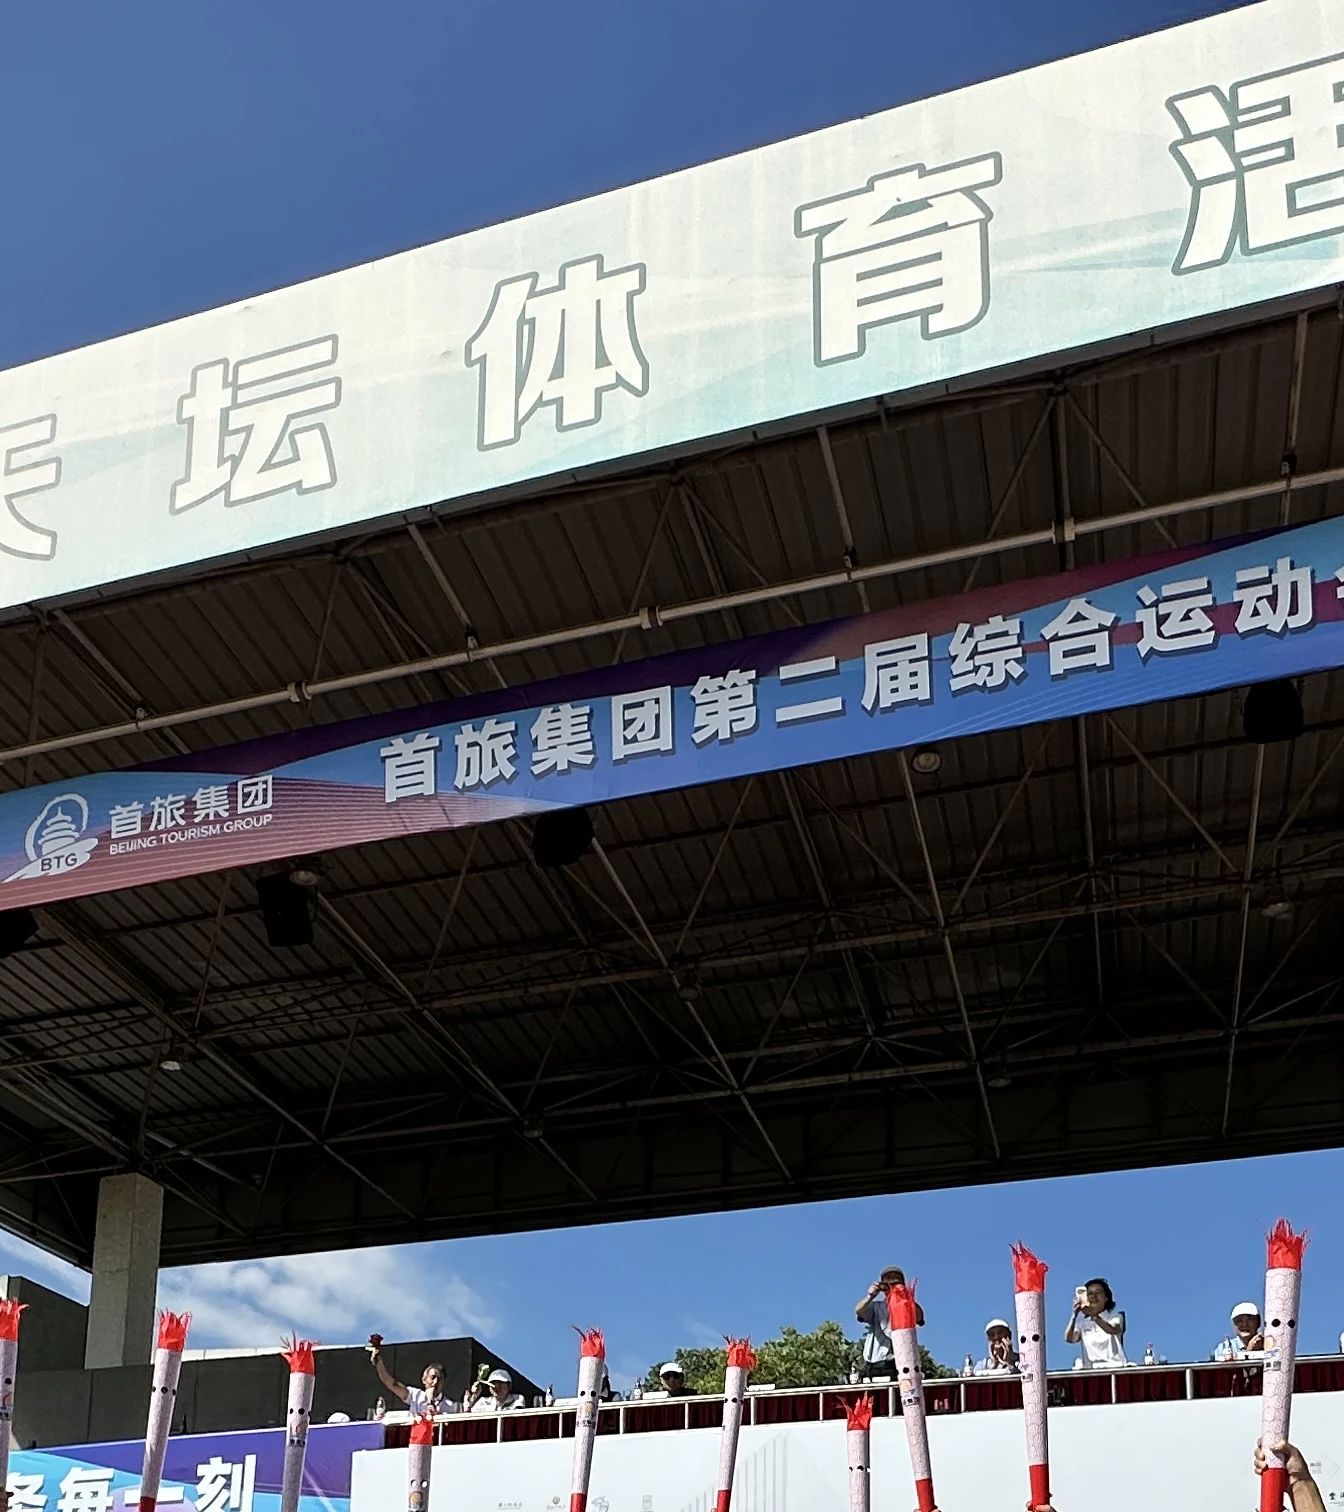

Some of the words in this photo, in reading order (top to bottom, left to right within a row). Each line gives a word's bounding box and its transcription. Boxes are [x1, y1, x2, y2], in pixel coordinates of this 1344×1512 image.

[109, 775, 274, 840] 首旅集团
[109, 834, 158, 856] BEIJING
[159, 823, 222, 847] TOURISM
[223, 814, 274, 838] GROUP
[40, 851, 79, 873] BTG
